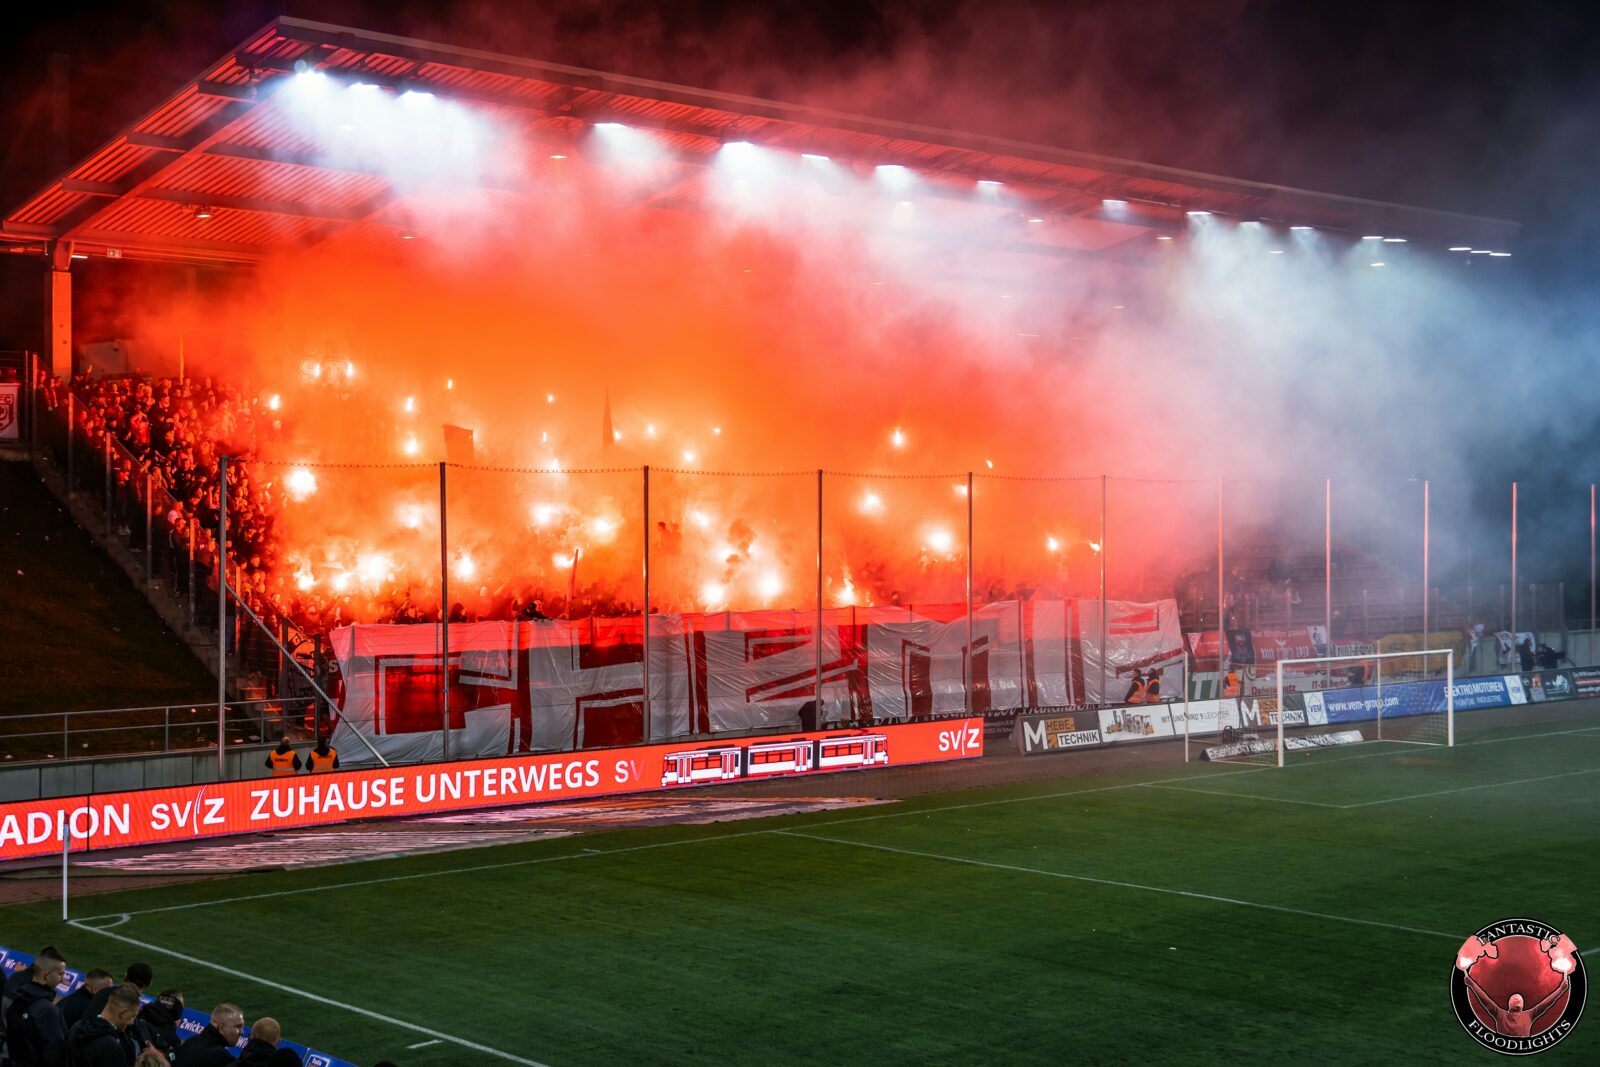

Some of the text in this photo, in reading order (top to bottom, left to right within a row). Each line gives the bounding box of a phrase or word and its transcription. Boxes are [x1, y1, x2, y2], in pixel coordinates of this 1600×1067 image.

[1443, 682, 1504, 697] EEKTROMOTOREN
[1328, 697, 1399, 711] www.vem-group.com
[1161, 715, 1171, 723] MIT
[1270, 711, 1303, 723] TEHNIK
[1023, 720, 1048, 752] M
[1046, 719, 1074, 731] HEBE-
[1059, 731, 1099, 746] TECHNIK
[250, 776, 405, 821] ZUHAUSE
[415, 759, 600, 803] UNTERWEGS
[180, 1018, 205, 1034] Zwicka
